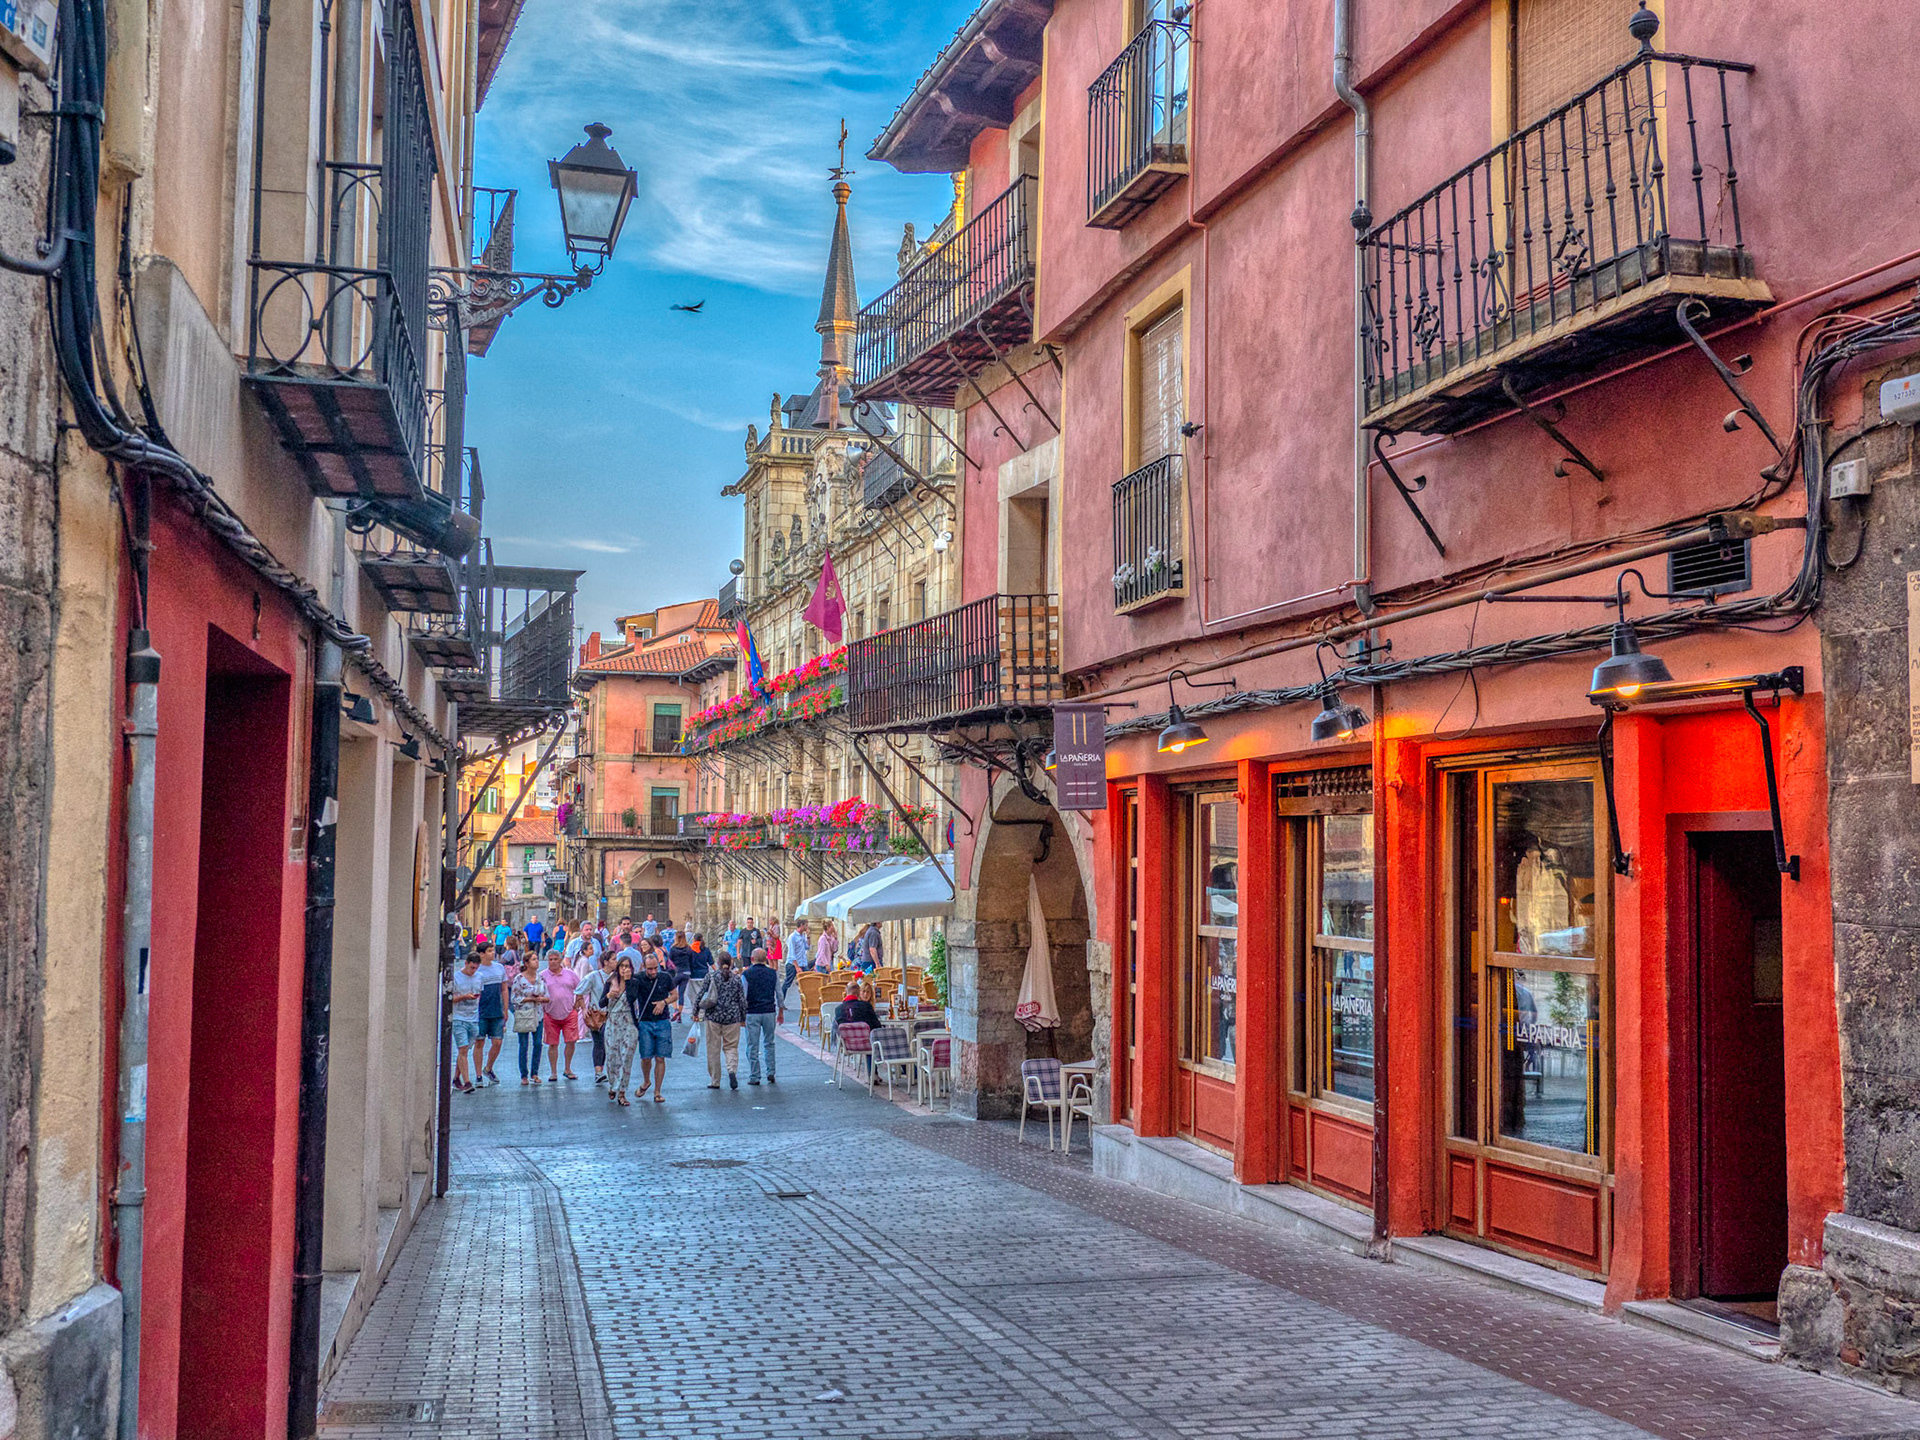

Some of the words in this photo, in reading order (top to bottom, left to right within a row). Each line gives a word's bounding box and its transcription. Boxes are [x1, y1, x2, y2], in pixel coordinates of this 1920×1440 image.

[1059, 754, 1068, 762] LA
[1068, 752, 1102, 762] PAÑERIA
[1340, 994, 1373, 1017] PAÑERIA
[1516, 1021, 1528, 1041] LA
